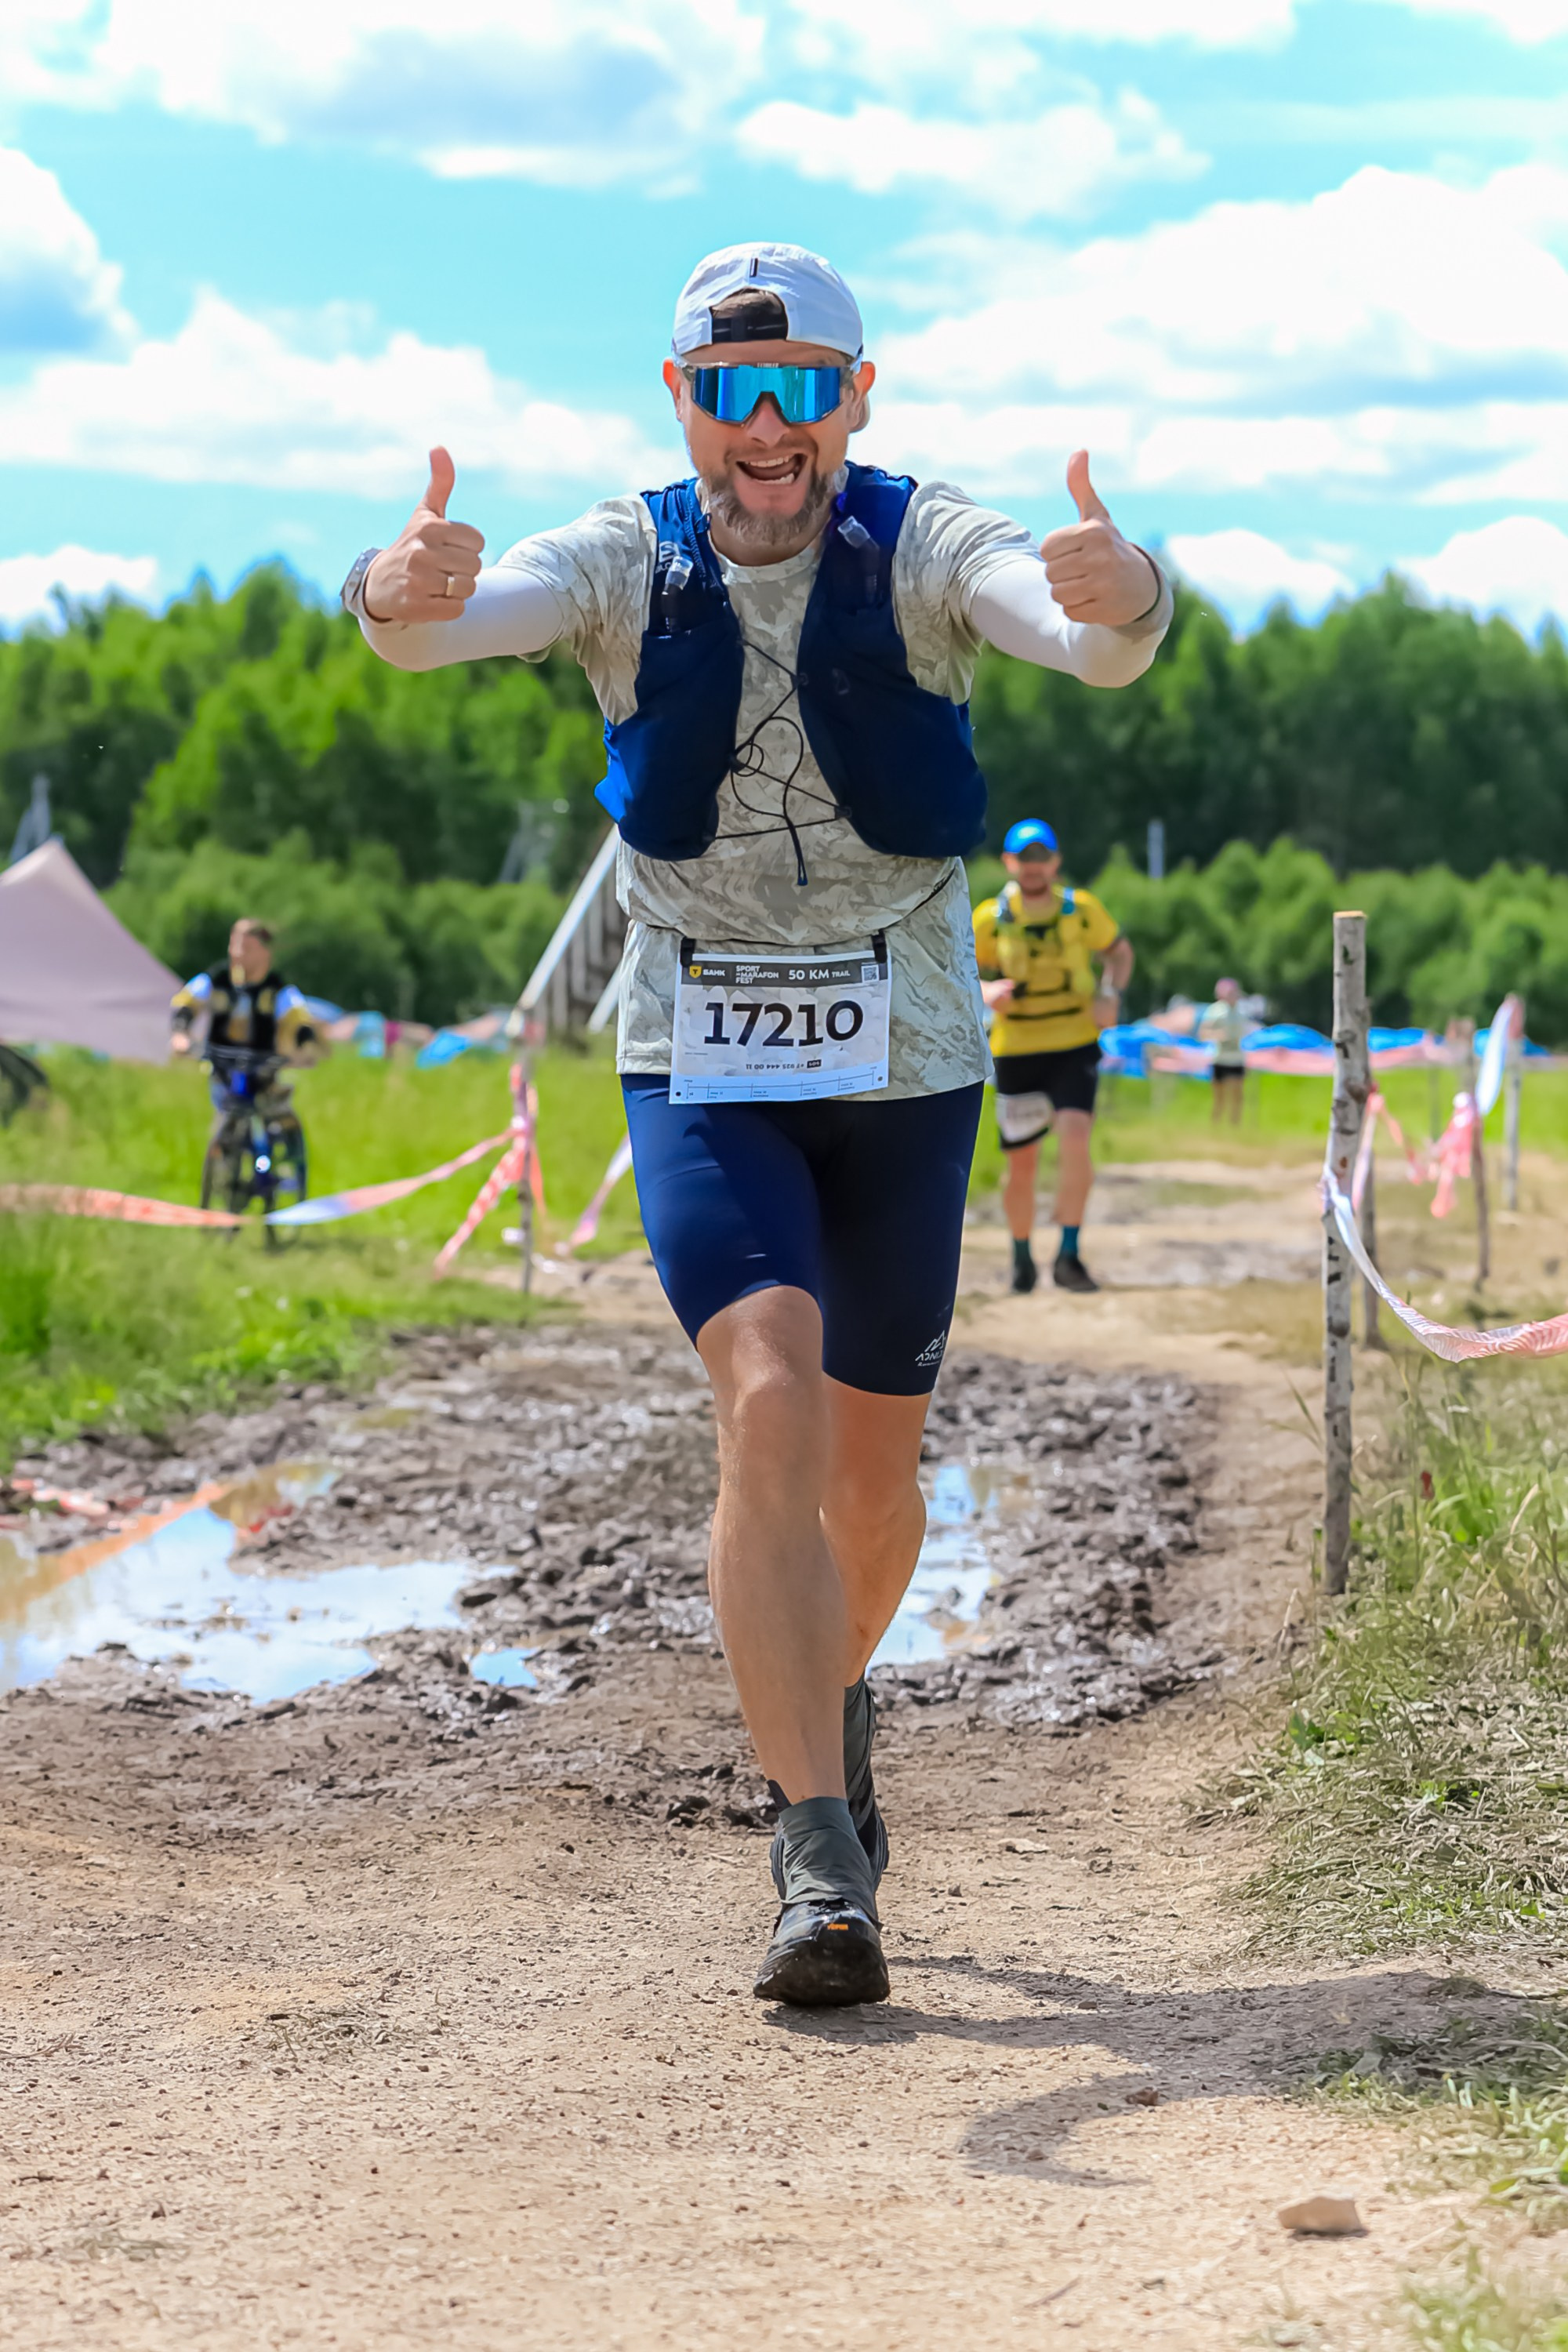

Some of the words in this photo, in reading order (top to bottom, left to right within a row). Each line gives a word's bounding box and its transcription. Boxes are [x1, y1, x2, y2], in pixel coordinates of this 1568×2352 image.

[788, 969, 806, 980] 50
[809, 968, 829, 979] KM
[704, 1000, 864, 1047] 17210
